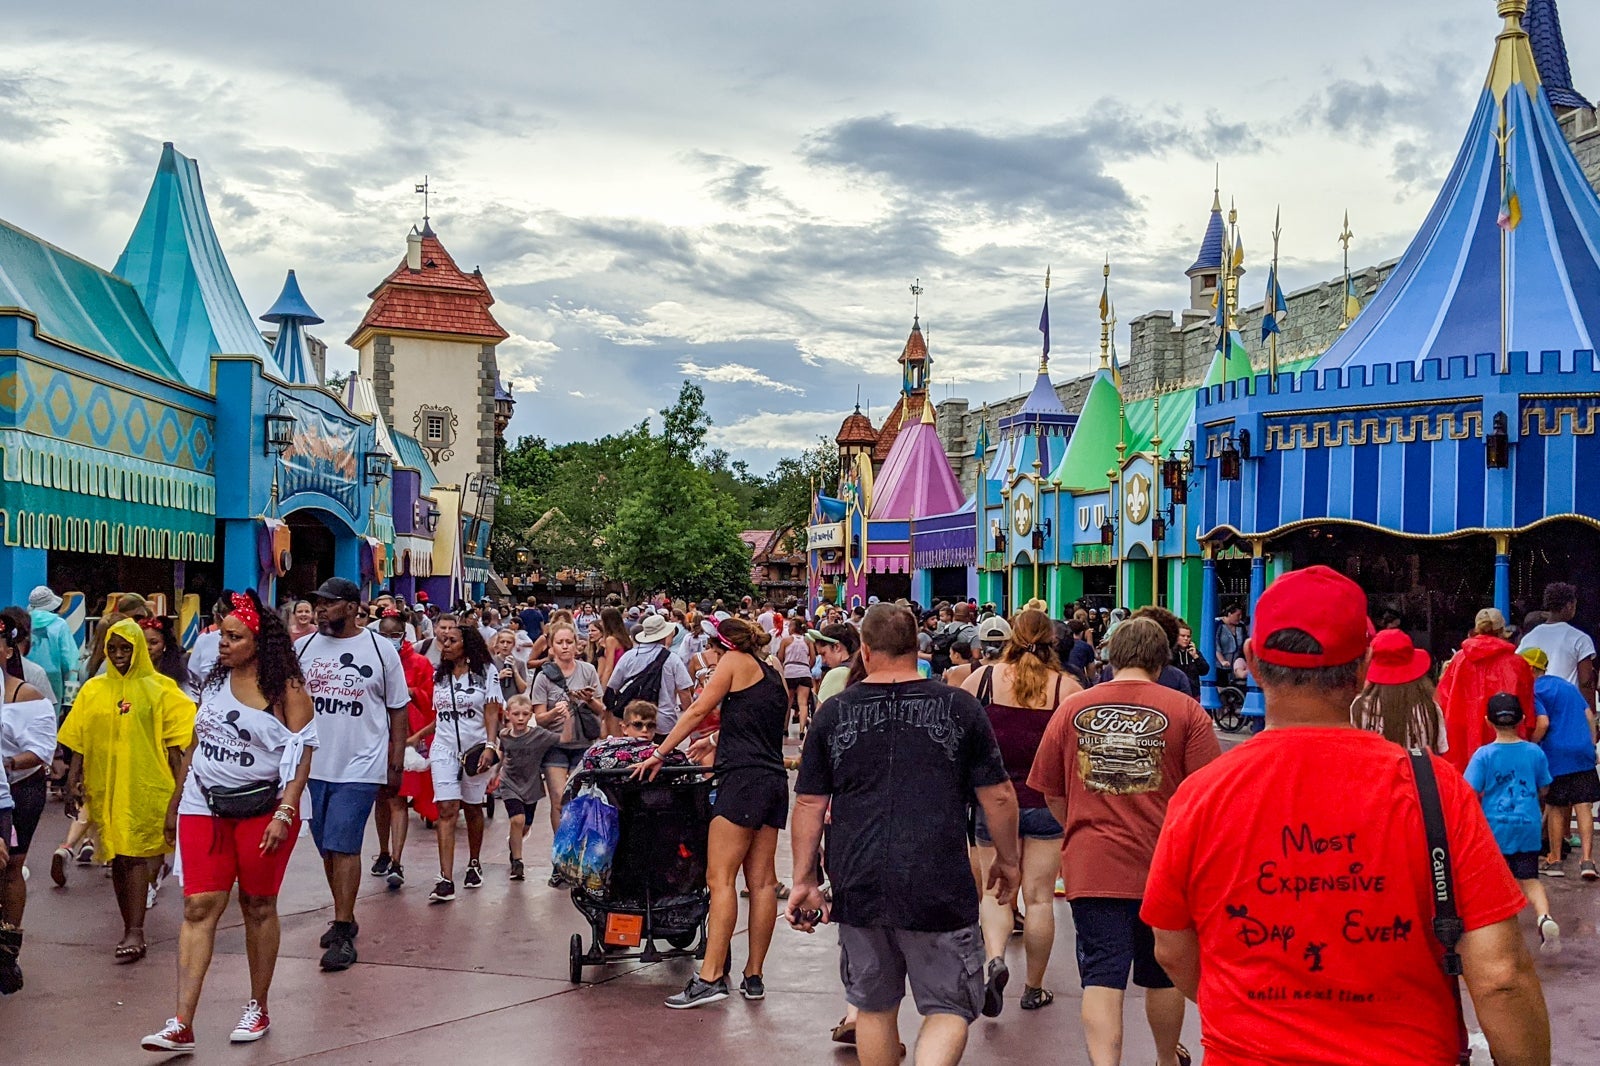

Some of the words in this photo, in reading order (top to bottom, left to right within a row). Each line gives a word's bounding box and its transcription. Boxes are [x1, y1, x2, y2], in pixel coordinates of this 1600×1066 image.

[1090, 707, 1151, 733] Ford
[1078, 736, 1104, 745] BUILT
[1256, 861, 1386, 901] Expensive
[1432, 847, 1448, 902] Canon
